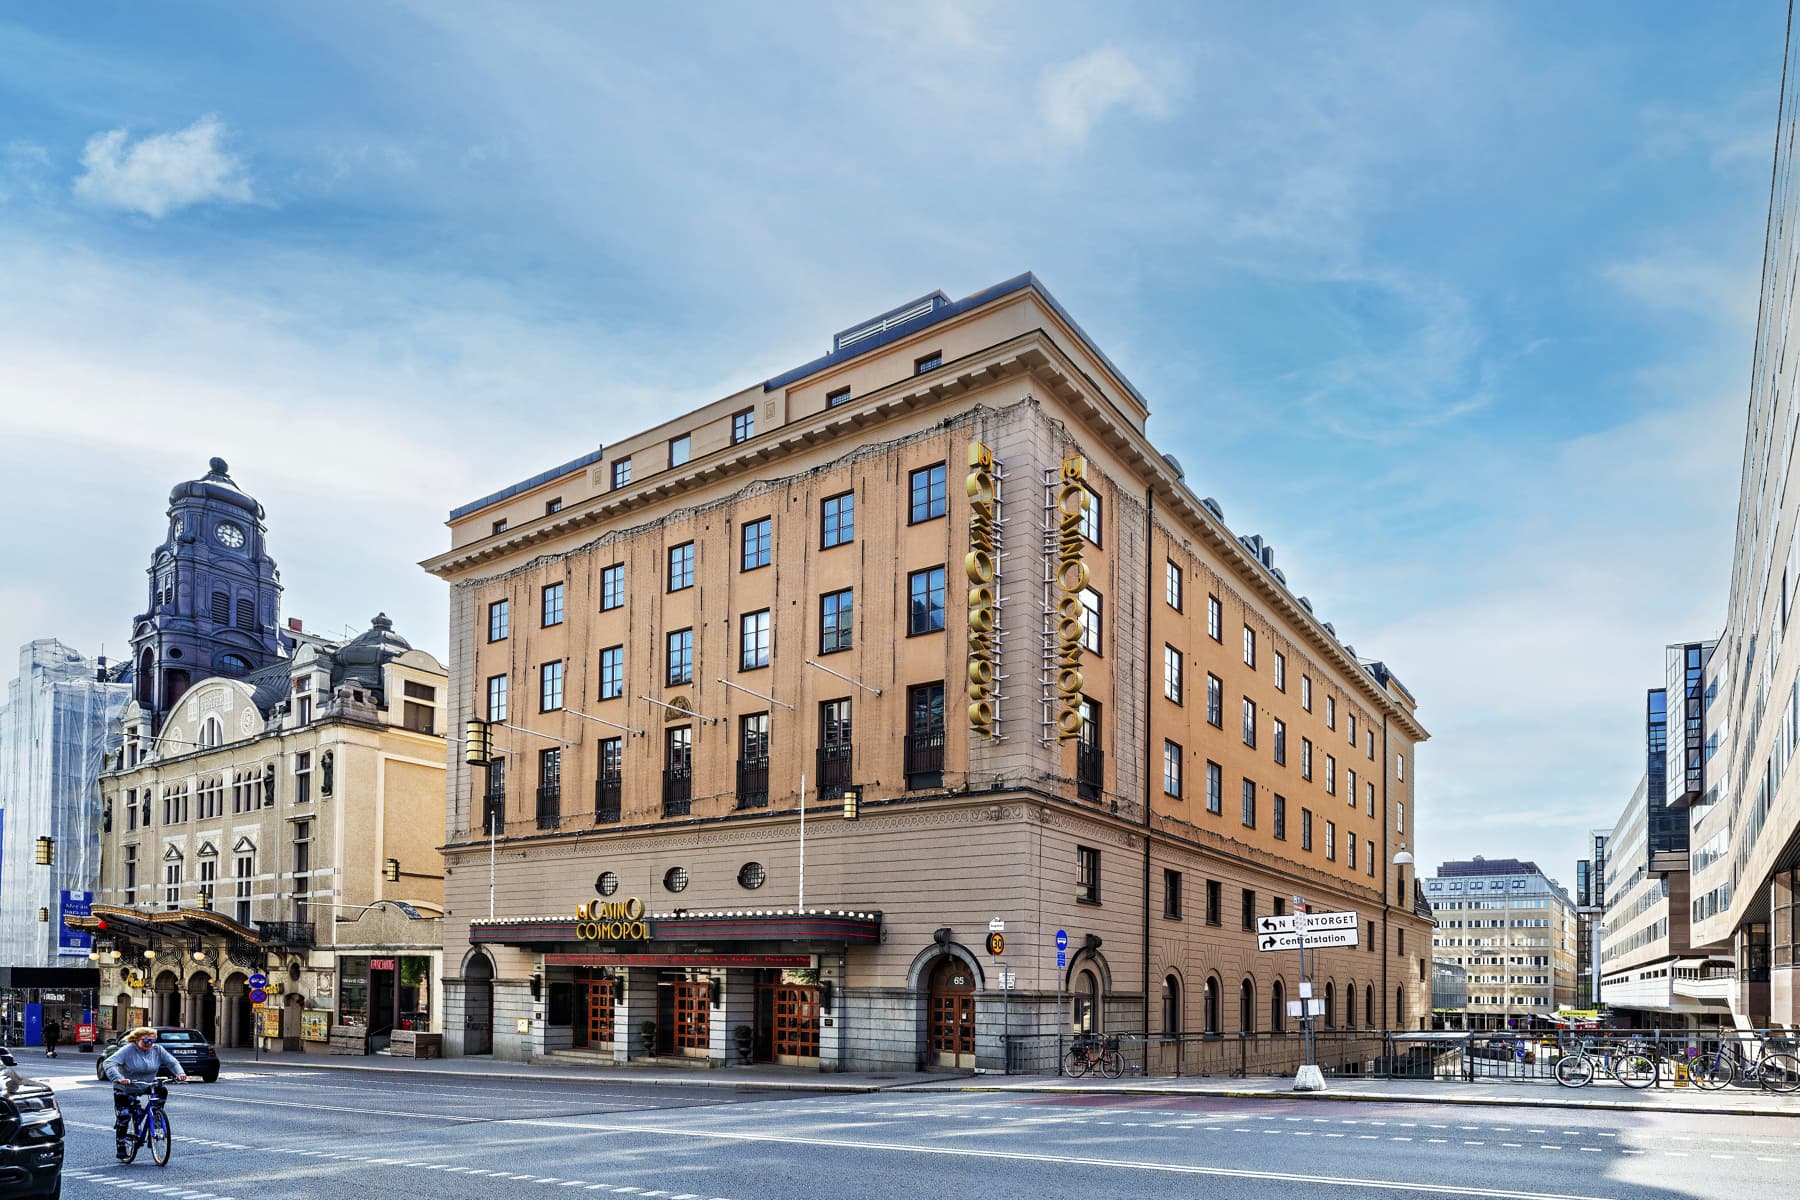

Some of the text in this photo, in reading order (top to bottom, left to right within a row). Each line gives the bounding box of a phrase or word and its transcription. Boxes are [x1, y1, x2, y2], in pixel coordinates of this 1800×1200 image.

[969, 586, 992, 740] COSMOPOL
[1056, 595, 1084, 747] COSMOPOL
[588, 896, 645, 920] CASINO
[1279, 920, 1286, 928] N
[1292, 915, 1354, 927] NTORGET
[576, 921, 652, 940] COSMOPOL
[993, 938, 1002, 949] 30
[1279, 935, 1346, 946] Centalstation
[954, 976, 964, 985] 65
